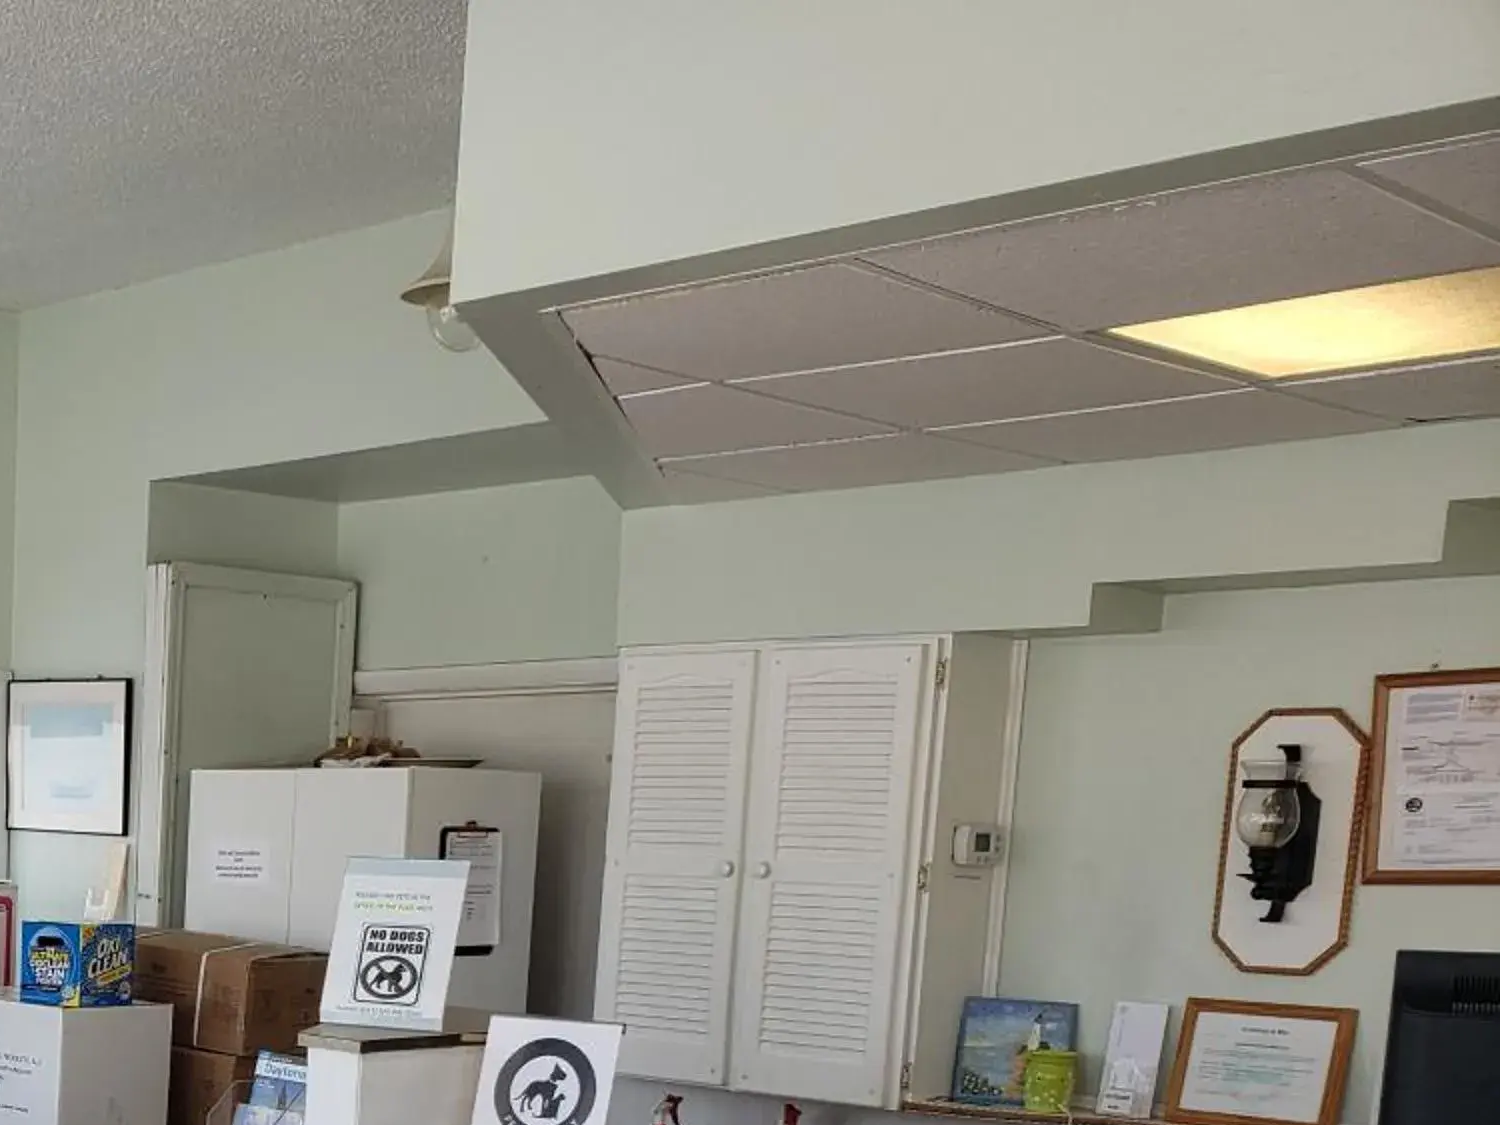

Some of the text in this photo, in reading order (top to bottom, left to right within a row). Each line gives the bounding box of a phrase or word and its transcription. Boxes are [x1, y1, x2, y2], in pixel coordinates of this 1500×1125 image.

[370, 929, 424, 942] NO DOGS
[366, 941, 423, 954] ALLOWED
